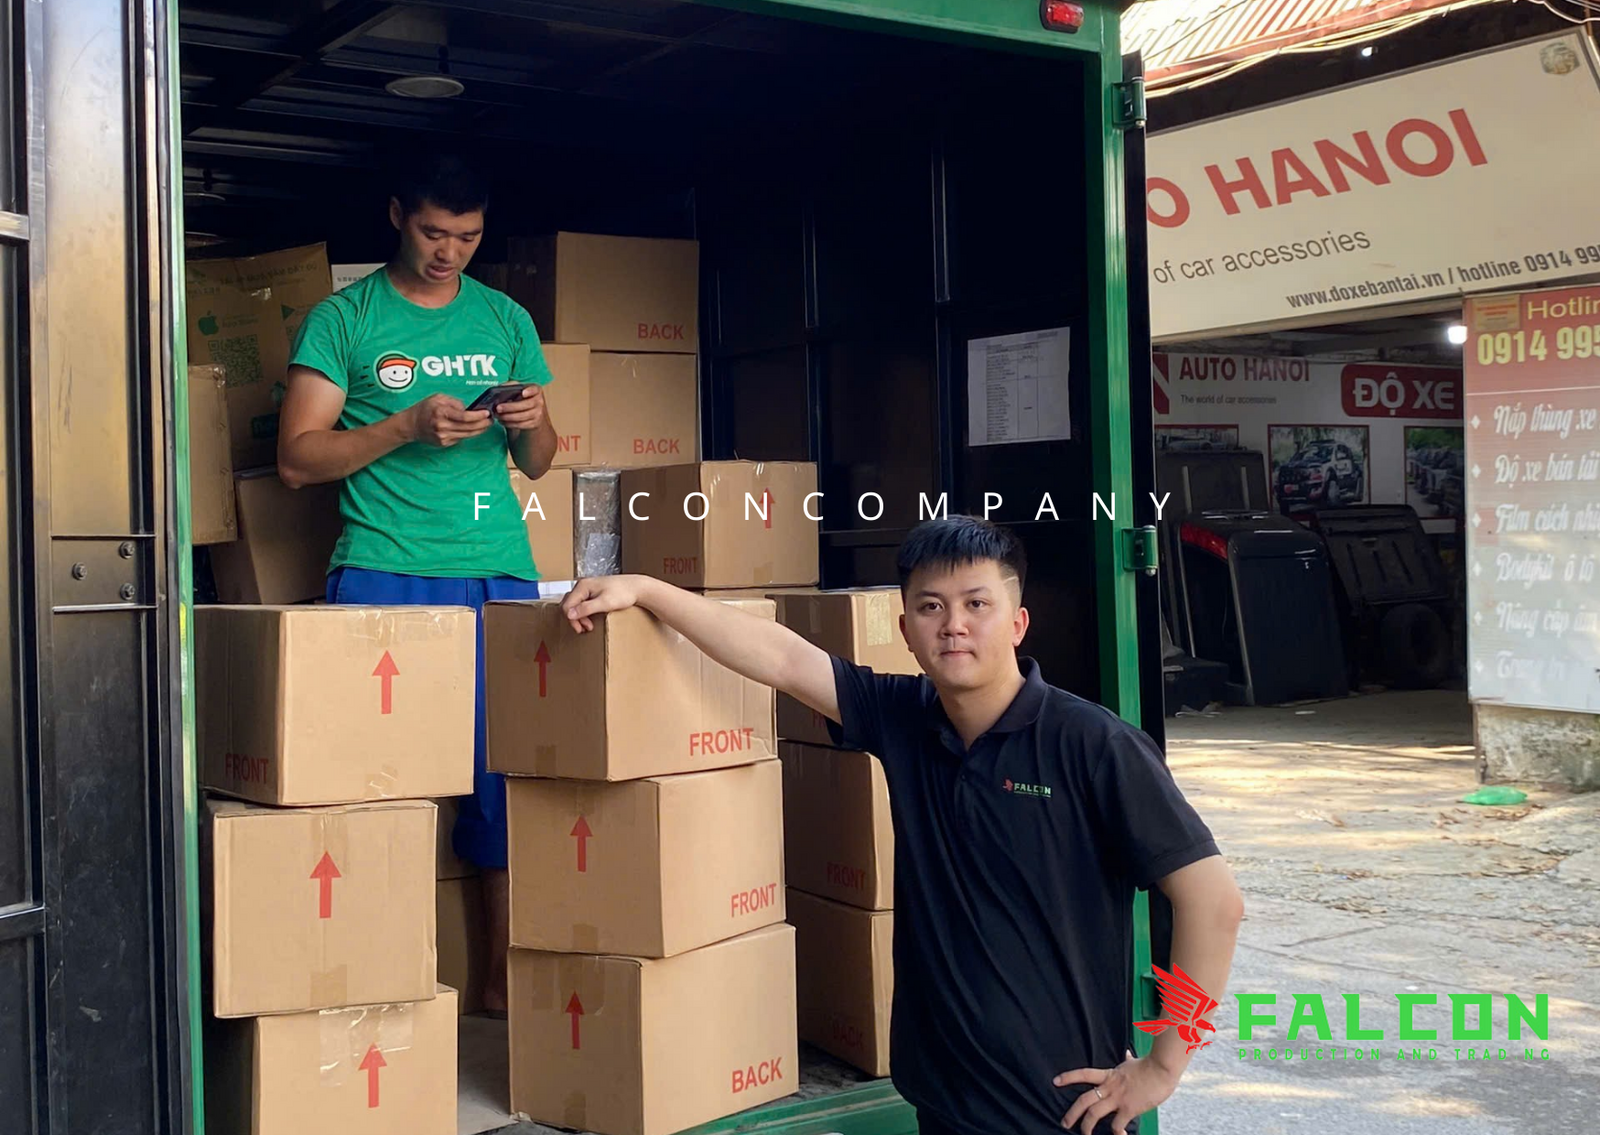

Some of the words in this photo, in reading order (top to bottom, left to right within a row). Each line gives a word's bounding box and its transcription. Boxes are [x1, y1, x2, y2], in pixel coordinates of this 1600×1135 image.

[1204, 108, 1488, 216] HANOI
[1152, 260, 1176, 284] of
[1180, 257, 1215, 279] car
[1221, 230, 1371, 272] accessories
[1286, 271, 1445, 309] www.doxebantai.vn
[1456, 260, 1522, 283] hotline
[1524, 250, 1572, 273] 0914
[1574, 244, 1600, 265] 99
[637, 323, 685, 341] BACK
[1477, 329, 1548, 366] 0914
[421, 354, 499, 377] GHTK
[1179, 357, 1236, 381] AUTO
[1244, 358, 1310, 382] HANOI
[1180, 394, 1194, 404] The
[1196, 394, 1215, 404] world
[1216, 394, 1224, 404] of
[1352, 371, 1405, 415] ĐỘ
[1412, 380, 1455, 410] XE
[632, 438, 681, 455] BACK
[1522, 458, 1542, 482] xe
[663, 557, 698, 575] FRONT
[690, 727, 754, 757] FRONT
[225, 752, 270, 785] FRONT
[1014, 783, 1051, 795] FALCON
[827, 861, 866, 891] FRONT
[731, 882, 777, 918] FRONT
[731, 1057, 783, 1094] BACK
